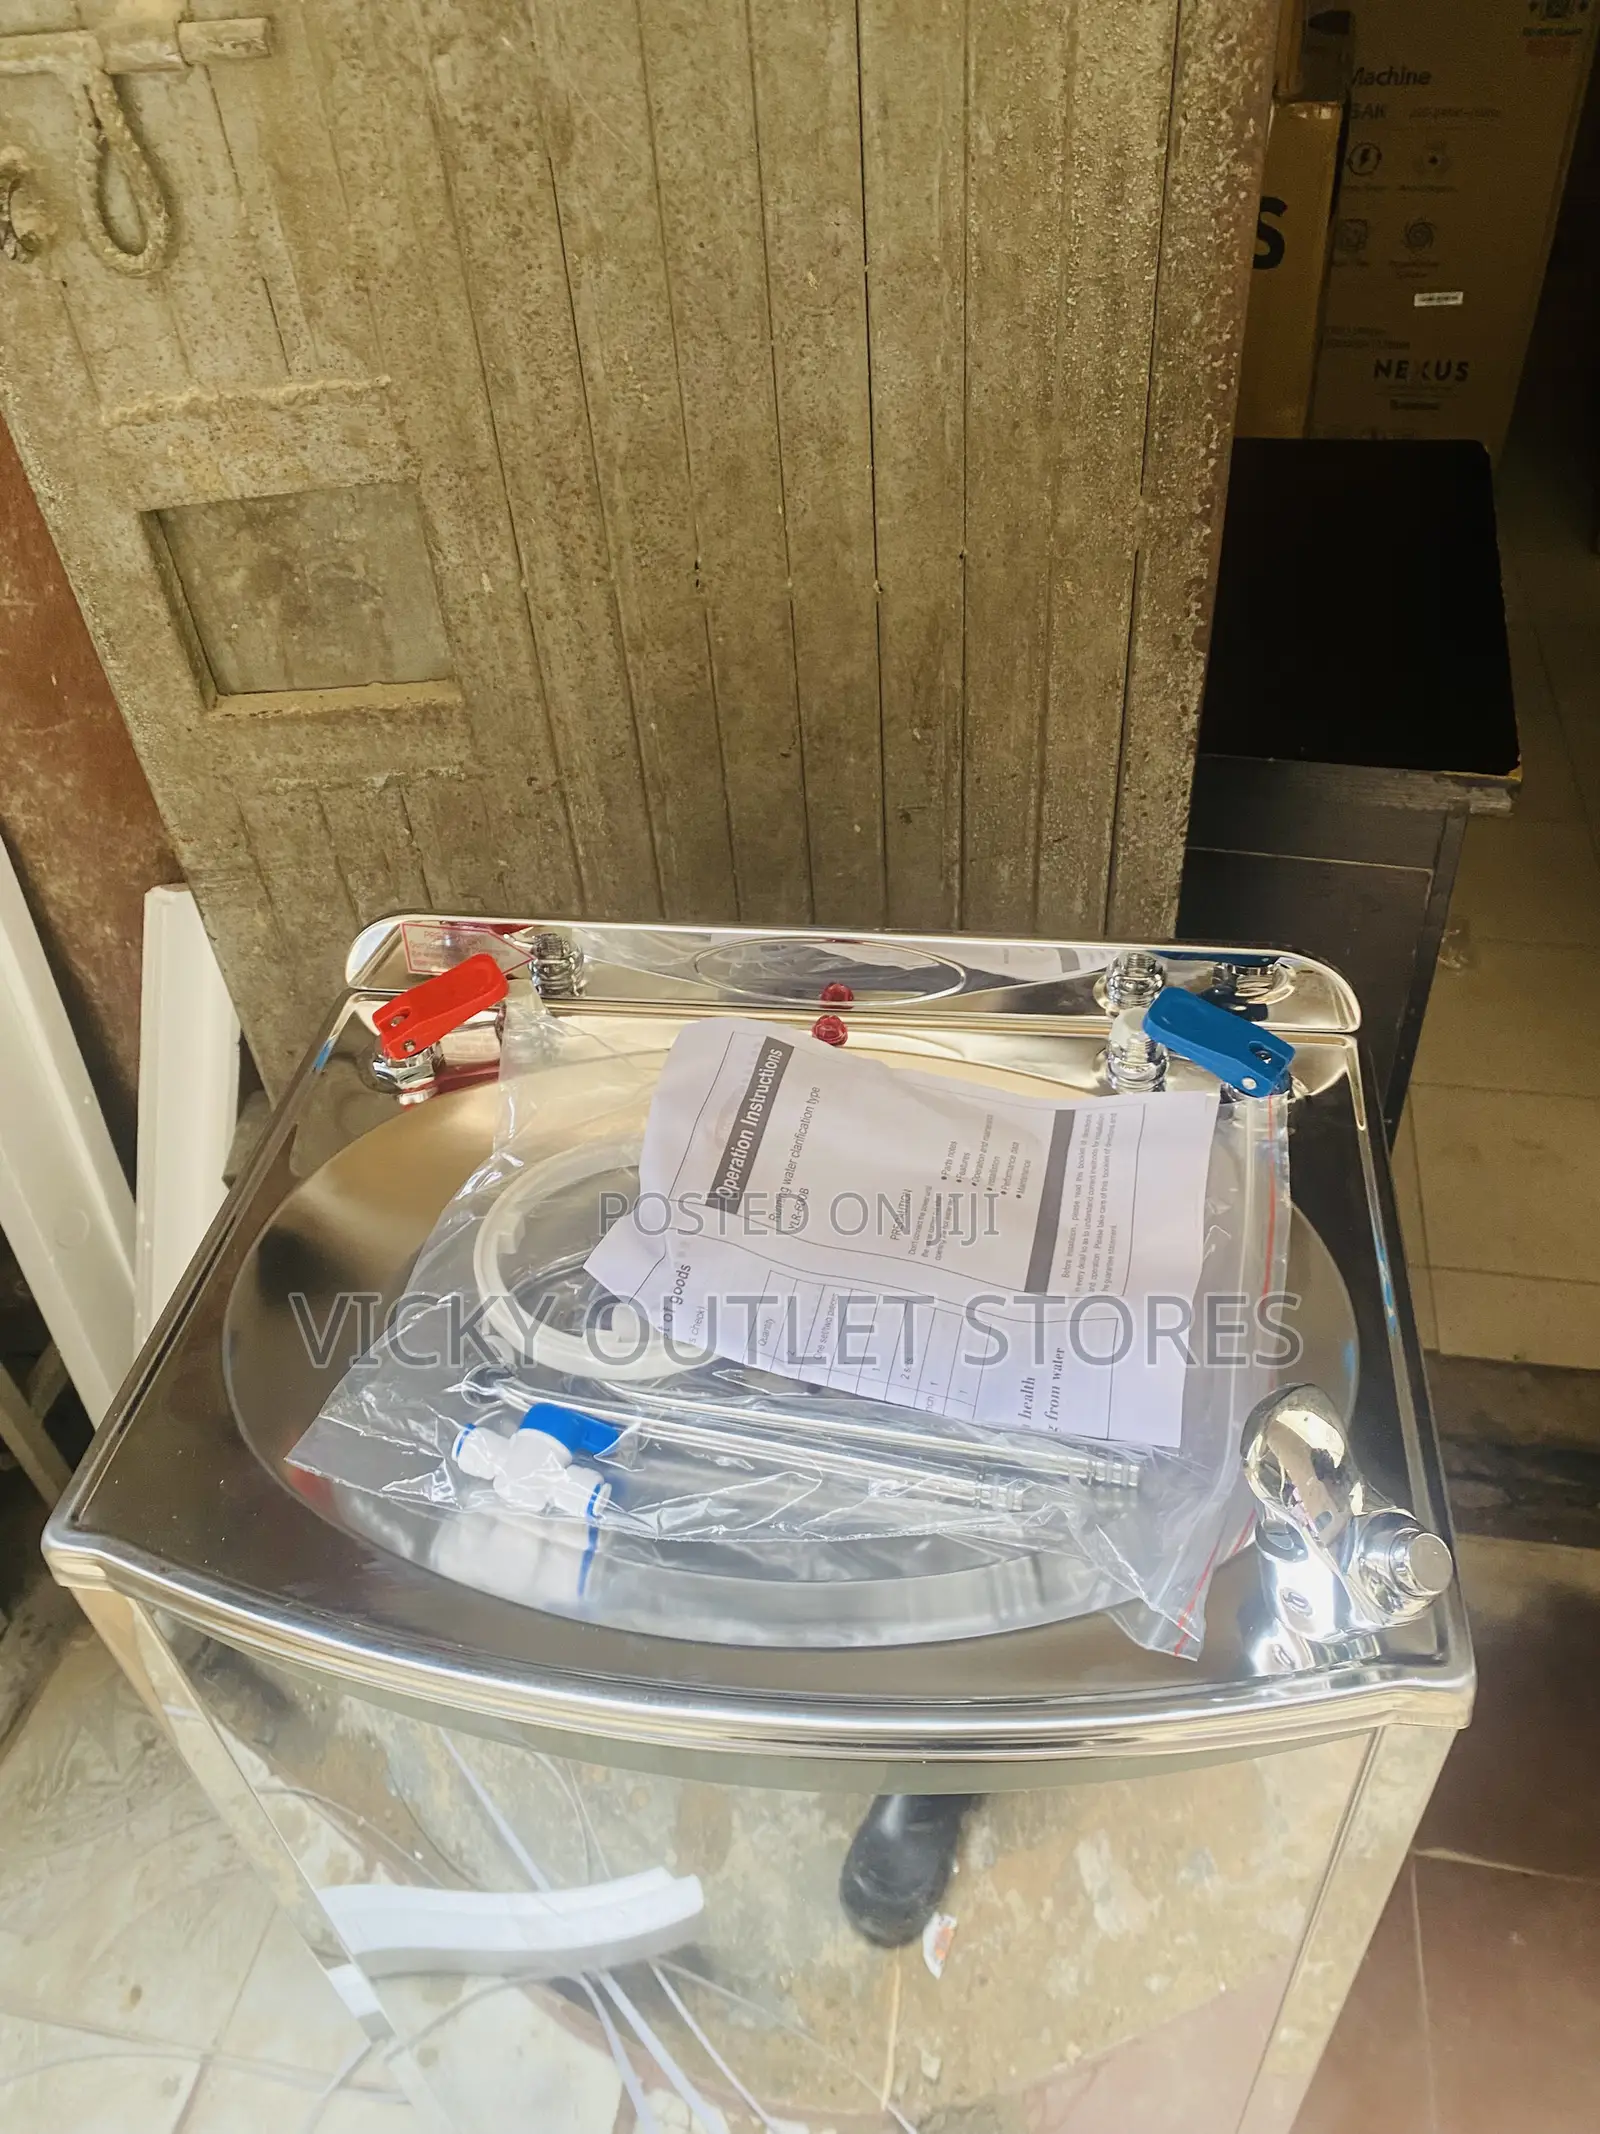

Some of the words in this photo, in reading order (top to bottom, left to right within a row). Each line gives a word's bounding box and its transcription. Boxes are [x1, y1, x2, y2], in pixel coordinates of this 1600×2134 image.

[1373, 358, 1470, 382] NEXUS
[716, 1130, 754, 1198] Operation
[741, 1048, 783, 1126] Instructions
[768, 1187, 791, 1222] Running
[783, 1158, 798, 1185] water
[791, 1106, 814, 1158] clarification
[806, 1087, 820, 1104] type
[941, 1160, 952, 1176] Parts
[948, 1141, 957, 1158] notes
[956, 1152, 971, 1179] Features
[972, 1154, 985, 1182] Operation
[980, 1142, 988, 1153] and
[1074, 1185, 1082, 1198] read
[1072, 1201, 1080, 1220] please
[1076, 1271, 1085, 1286] every
[1085, 1197, 1094, 1229] understand
[1093, 1229, 1104, 1249] Please
[1061, 1260, 1072, 1278] Before
[663, 1306, 673, 1322] of
[670, 1264, 691, 1304] goods
[758, 1317, 775, 1346] Quantity
[813, 1345, 825, 1360] One
[1018, 1377, 1035, 1420] health
[1044, 1385, 1060, 1421] from
[1052, 1348, 1065, 1380] water
